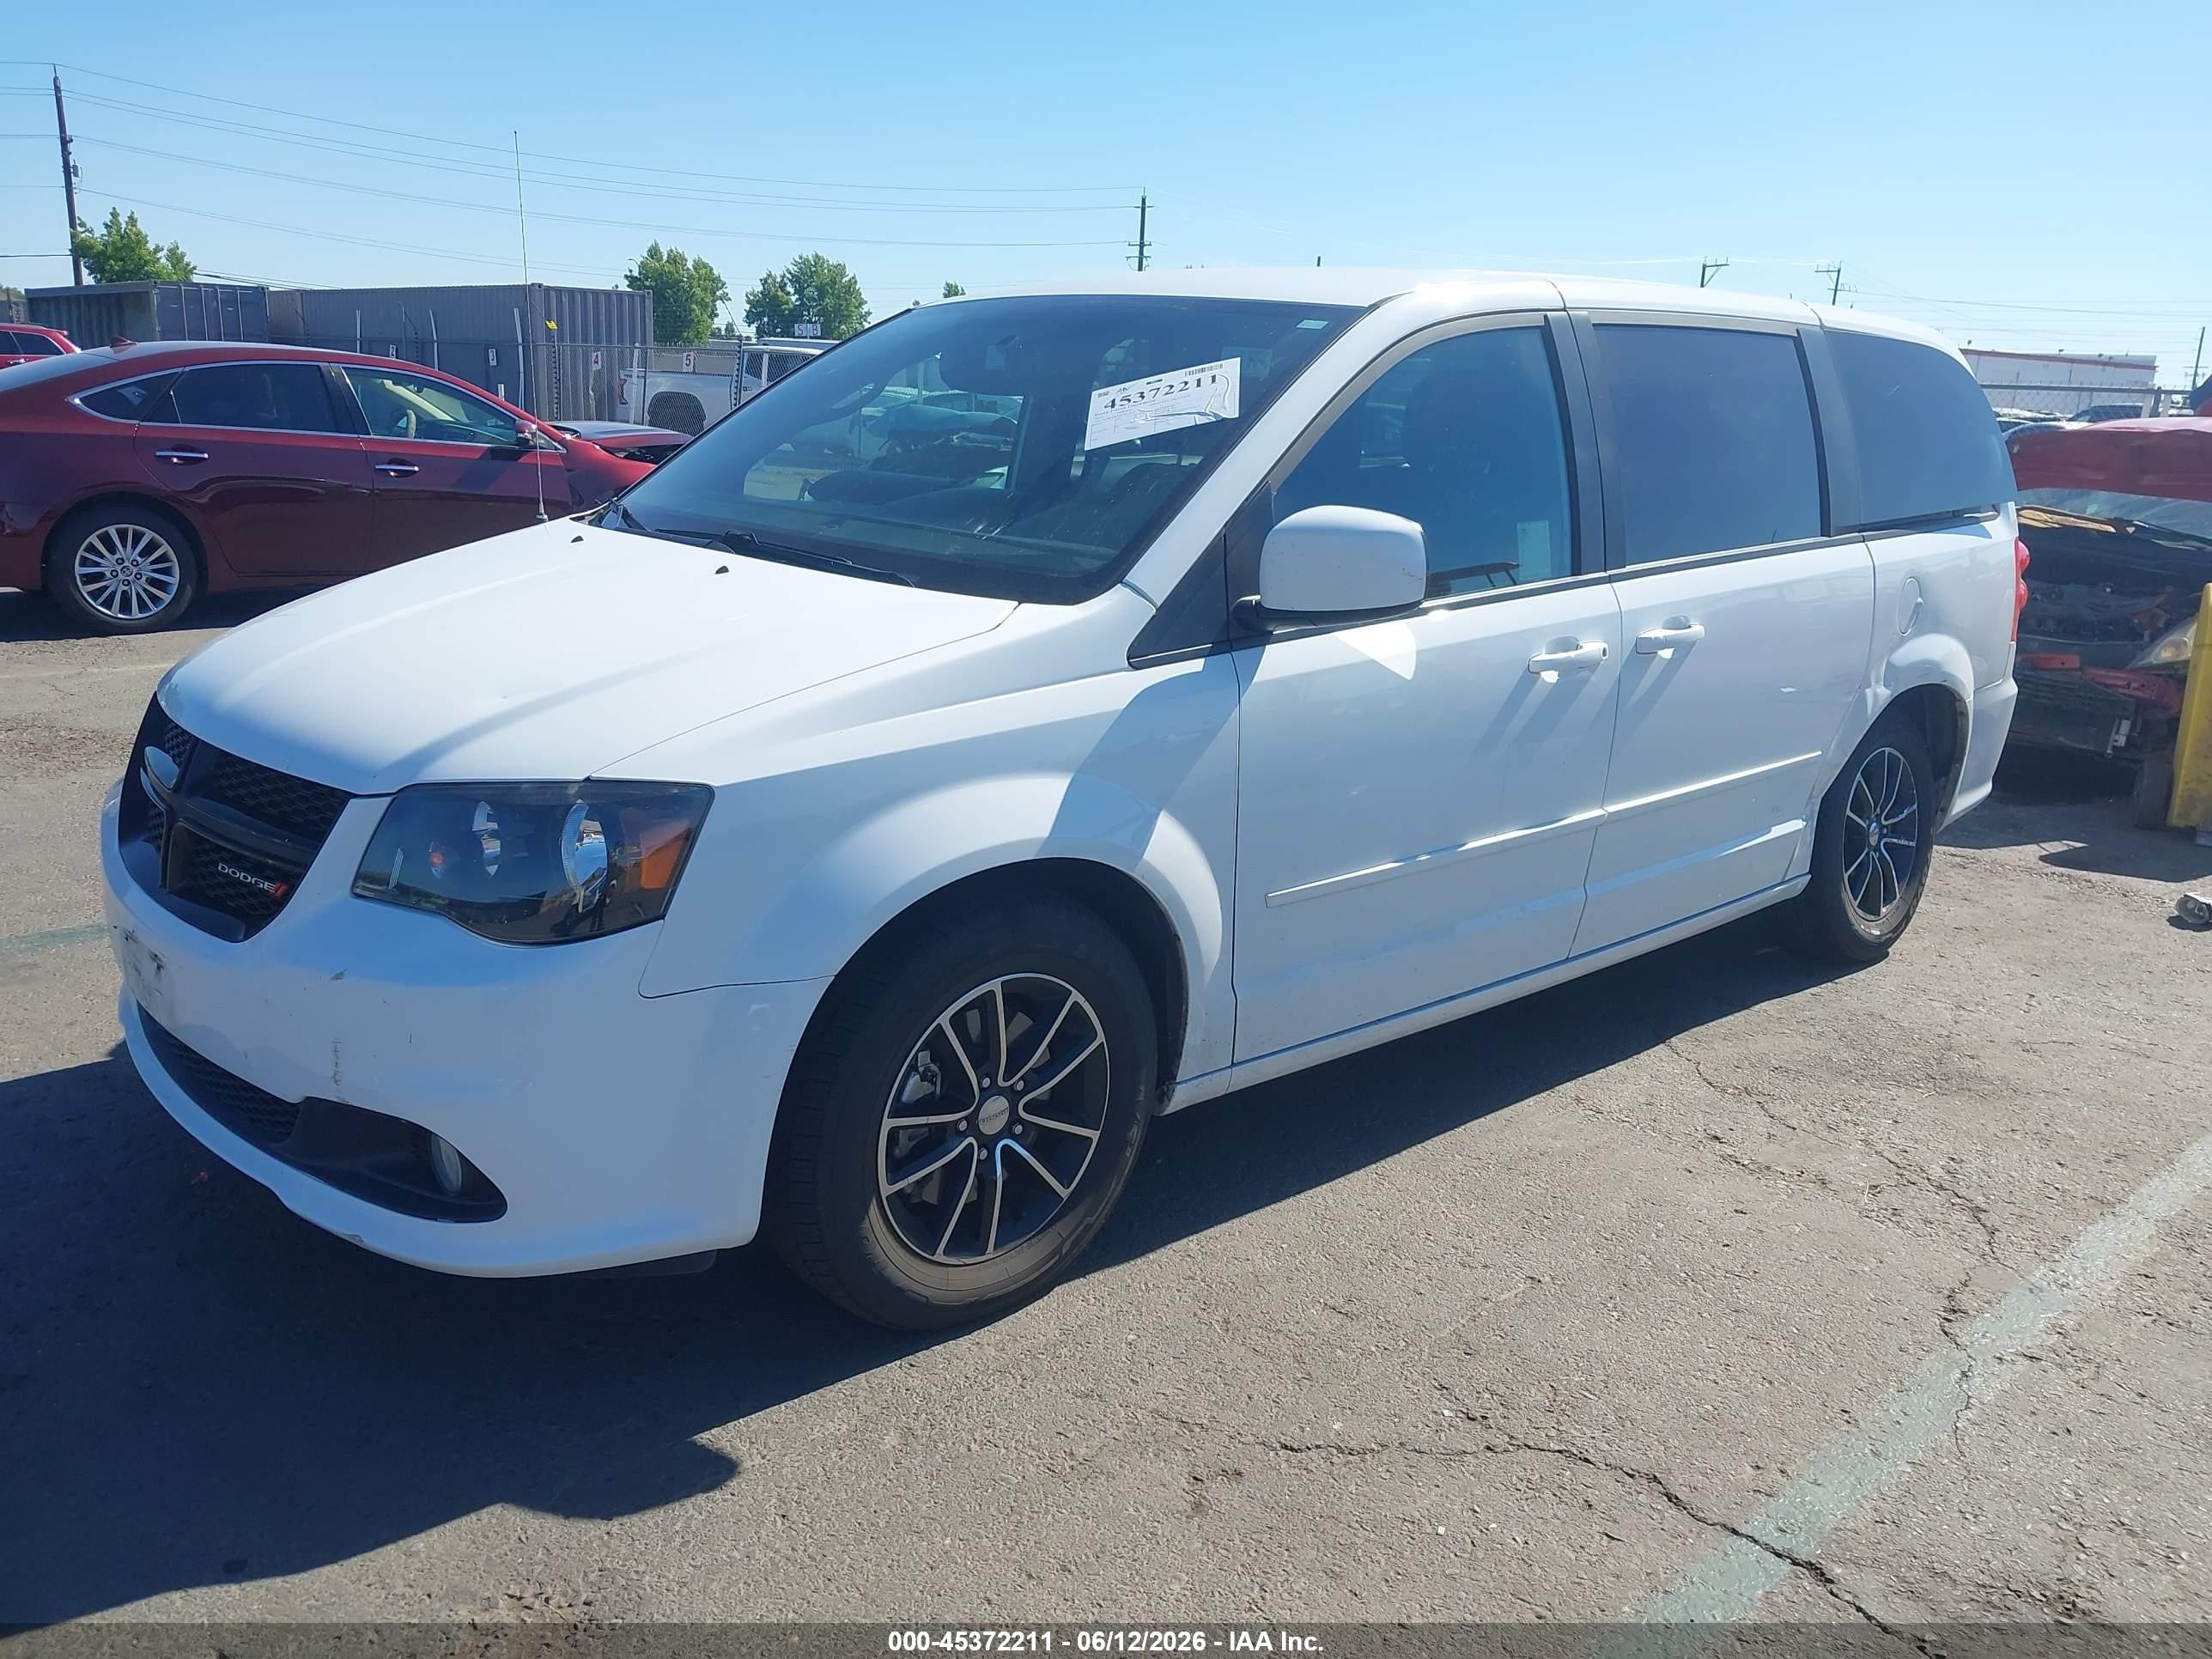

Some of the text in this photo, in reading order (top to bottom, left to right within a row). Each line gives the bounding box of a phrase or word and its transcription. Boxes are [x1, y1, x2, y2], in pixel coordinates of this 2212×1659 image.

[797, 325, 818, 336] S B
[593, 353, 599, 366] 4
[685, 354, 691, 367] 5
[1103, 374, 1218, 410] 45372211
[218, 862, 276, 893] DODGE
